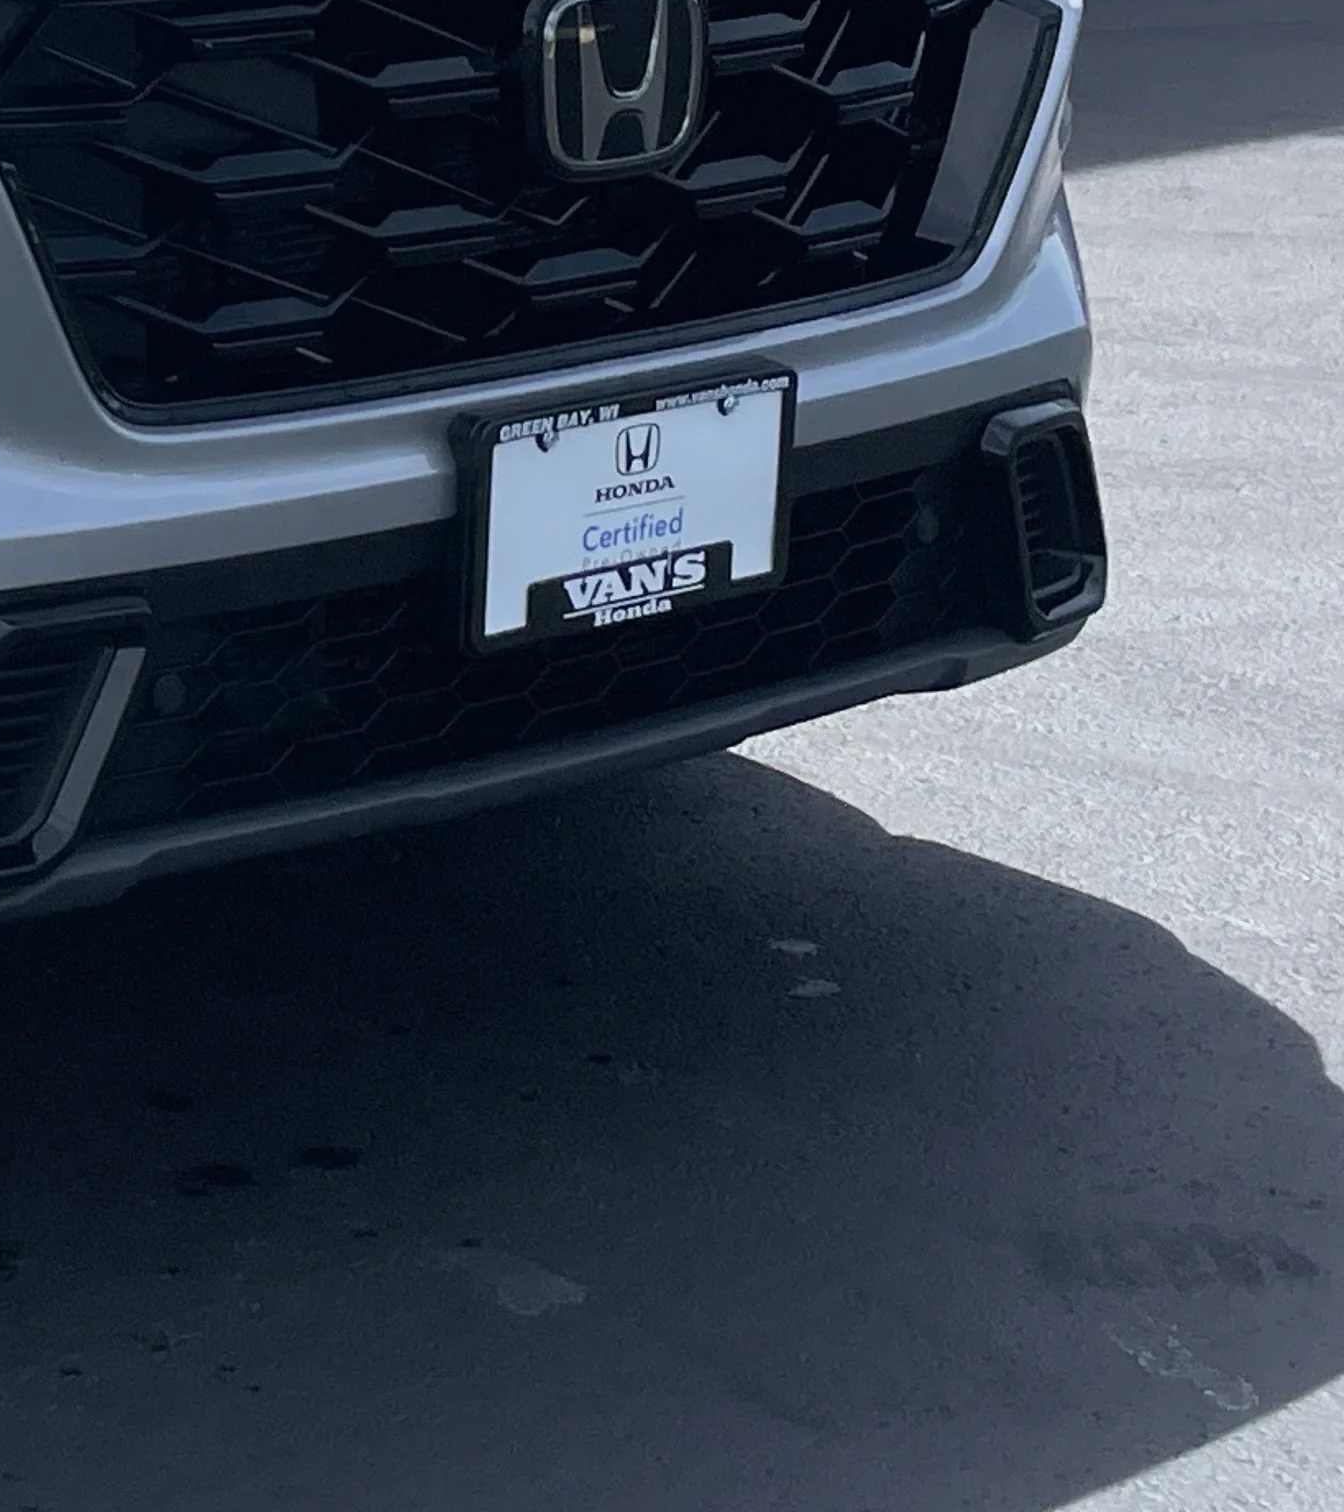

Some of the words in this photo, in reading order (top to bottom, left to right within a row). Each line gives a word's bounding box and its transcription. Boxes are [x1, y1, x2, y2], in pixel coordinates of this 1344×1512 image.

[499, 415, 555, 442] GREEN
[595, 475, 676, 504] HONDA
[582, 506, 684, 552] Certified
[594, 596, 673, 627] Honda
